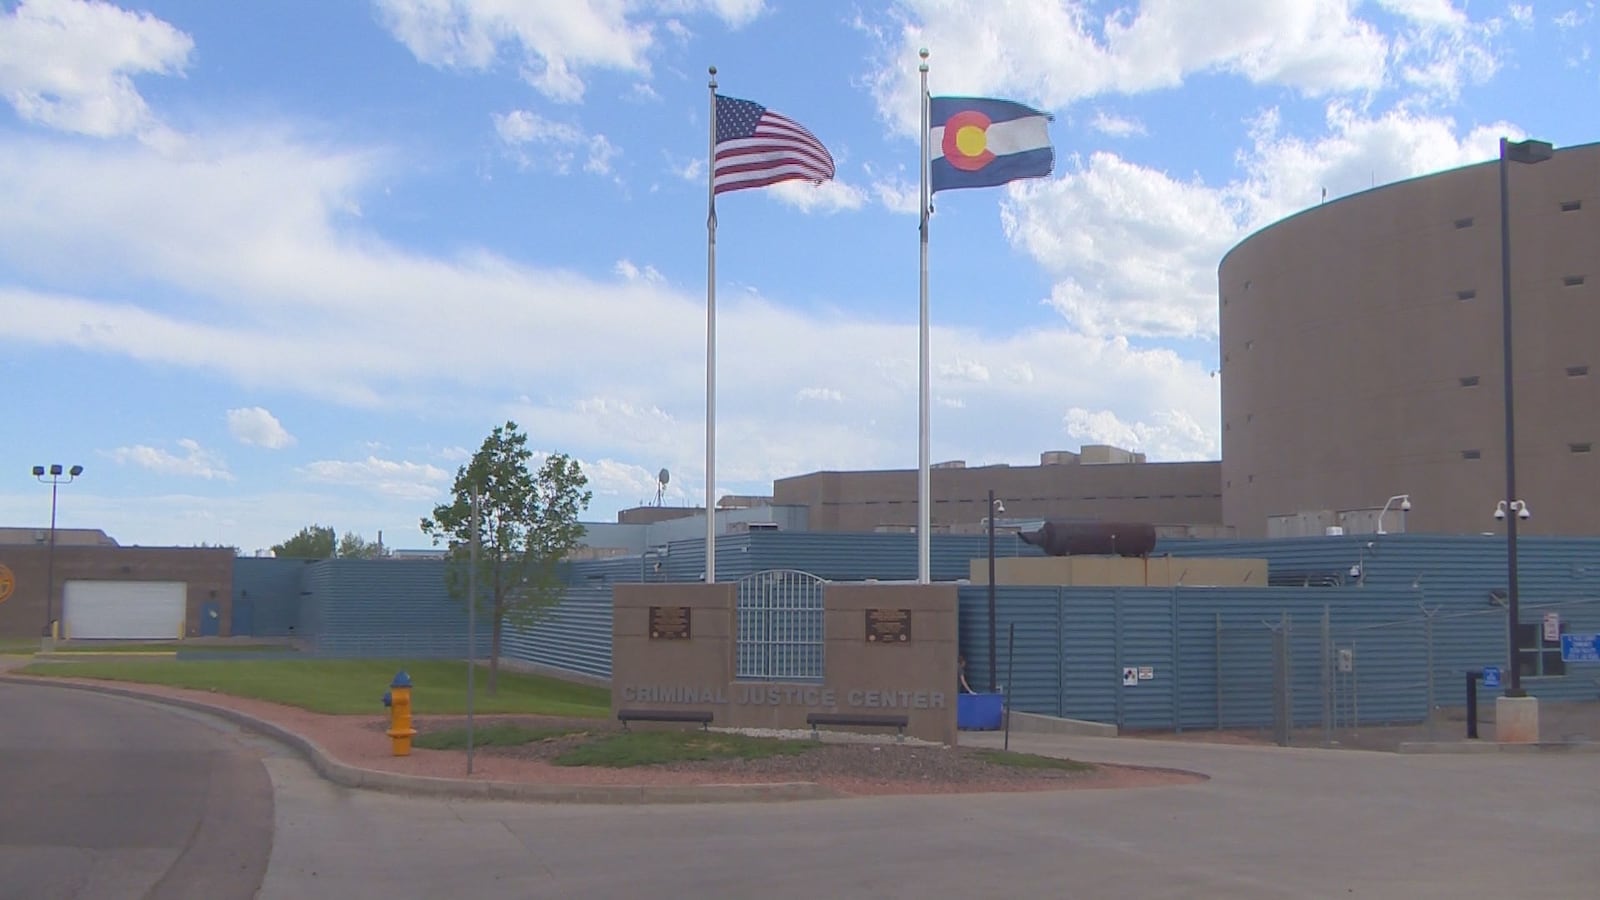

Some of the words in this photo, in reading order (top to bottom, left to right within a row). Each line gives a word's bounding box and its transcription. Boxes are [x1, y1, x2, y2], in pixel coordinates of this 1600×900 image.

[622, 686, 728, 704] CRIMINAL
[737, 687, 837, 706] JUSTICE
[848, 689, 945, 709] CENTER
